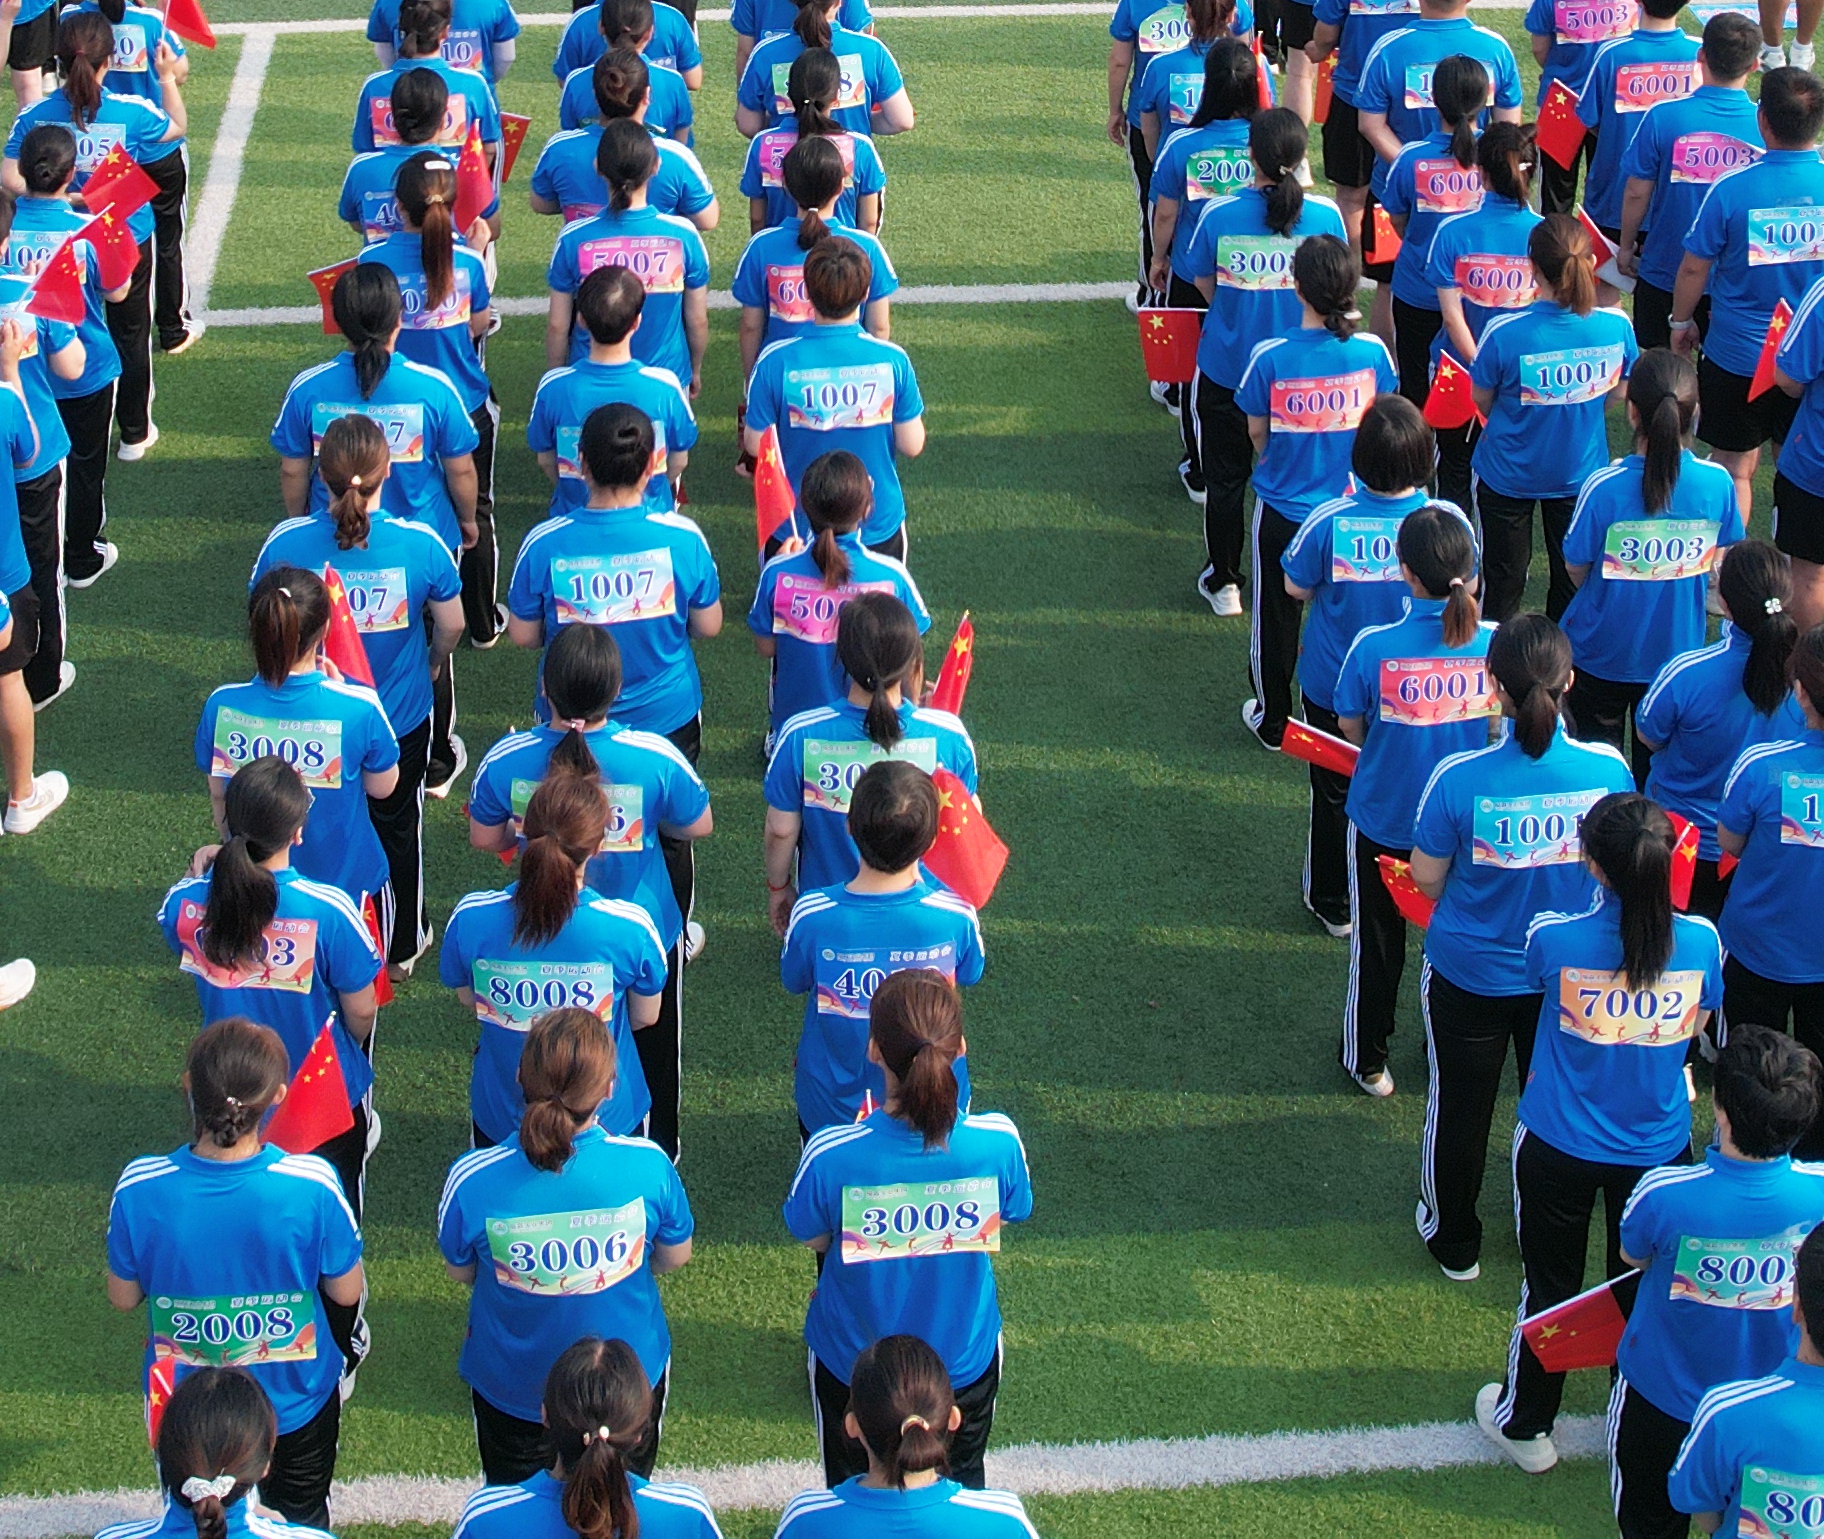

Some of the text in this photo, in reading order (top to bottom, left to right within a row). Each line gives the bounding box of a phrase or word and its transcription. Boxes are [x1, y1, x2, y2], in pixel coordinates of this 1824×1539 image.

[1567, 5, 1628, 30] 5003
[1150, 22, 1190, 42] 300
[1629, 73, 1694, 94] 6001
[1684, 144, 1754, 167] 5003
[1197, 159, 1252, 183] 200
[1429, 168, 1478, 192] 600
[1229, 250, 1287, 274] 300
[1538, 361, 1607, 388] 1001
[801, 383, 876, 409] 1007
[1287, 388, 1358, 414] 6001
[1620, 536, 1703, 565] 3003
[570, 572, 653, 602] 1007
[1399, 670, 1488, 703] 6001
[229, 734, 325, 767] 3008
[490, 978, 593, 1007] 8008
[1579, 988, 1682, 1020] 7002
[863, 1201, 980, 1237] 3008
[508, 1232, 627, 1273] 3006
[1697, 1255, 1793, 1285] 800
[174, 1307, 293, 1344] 2008
